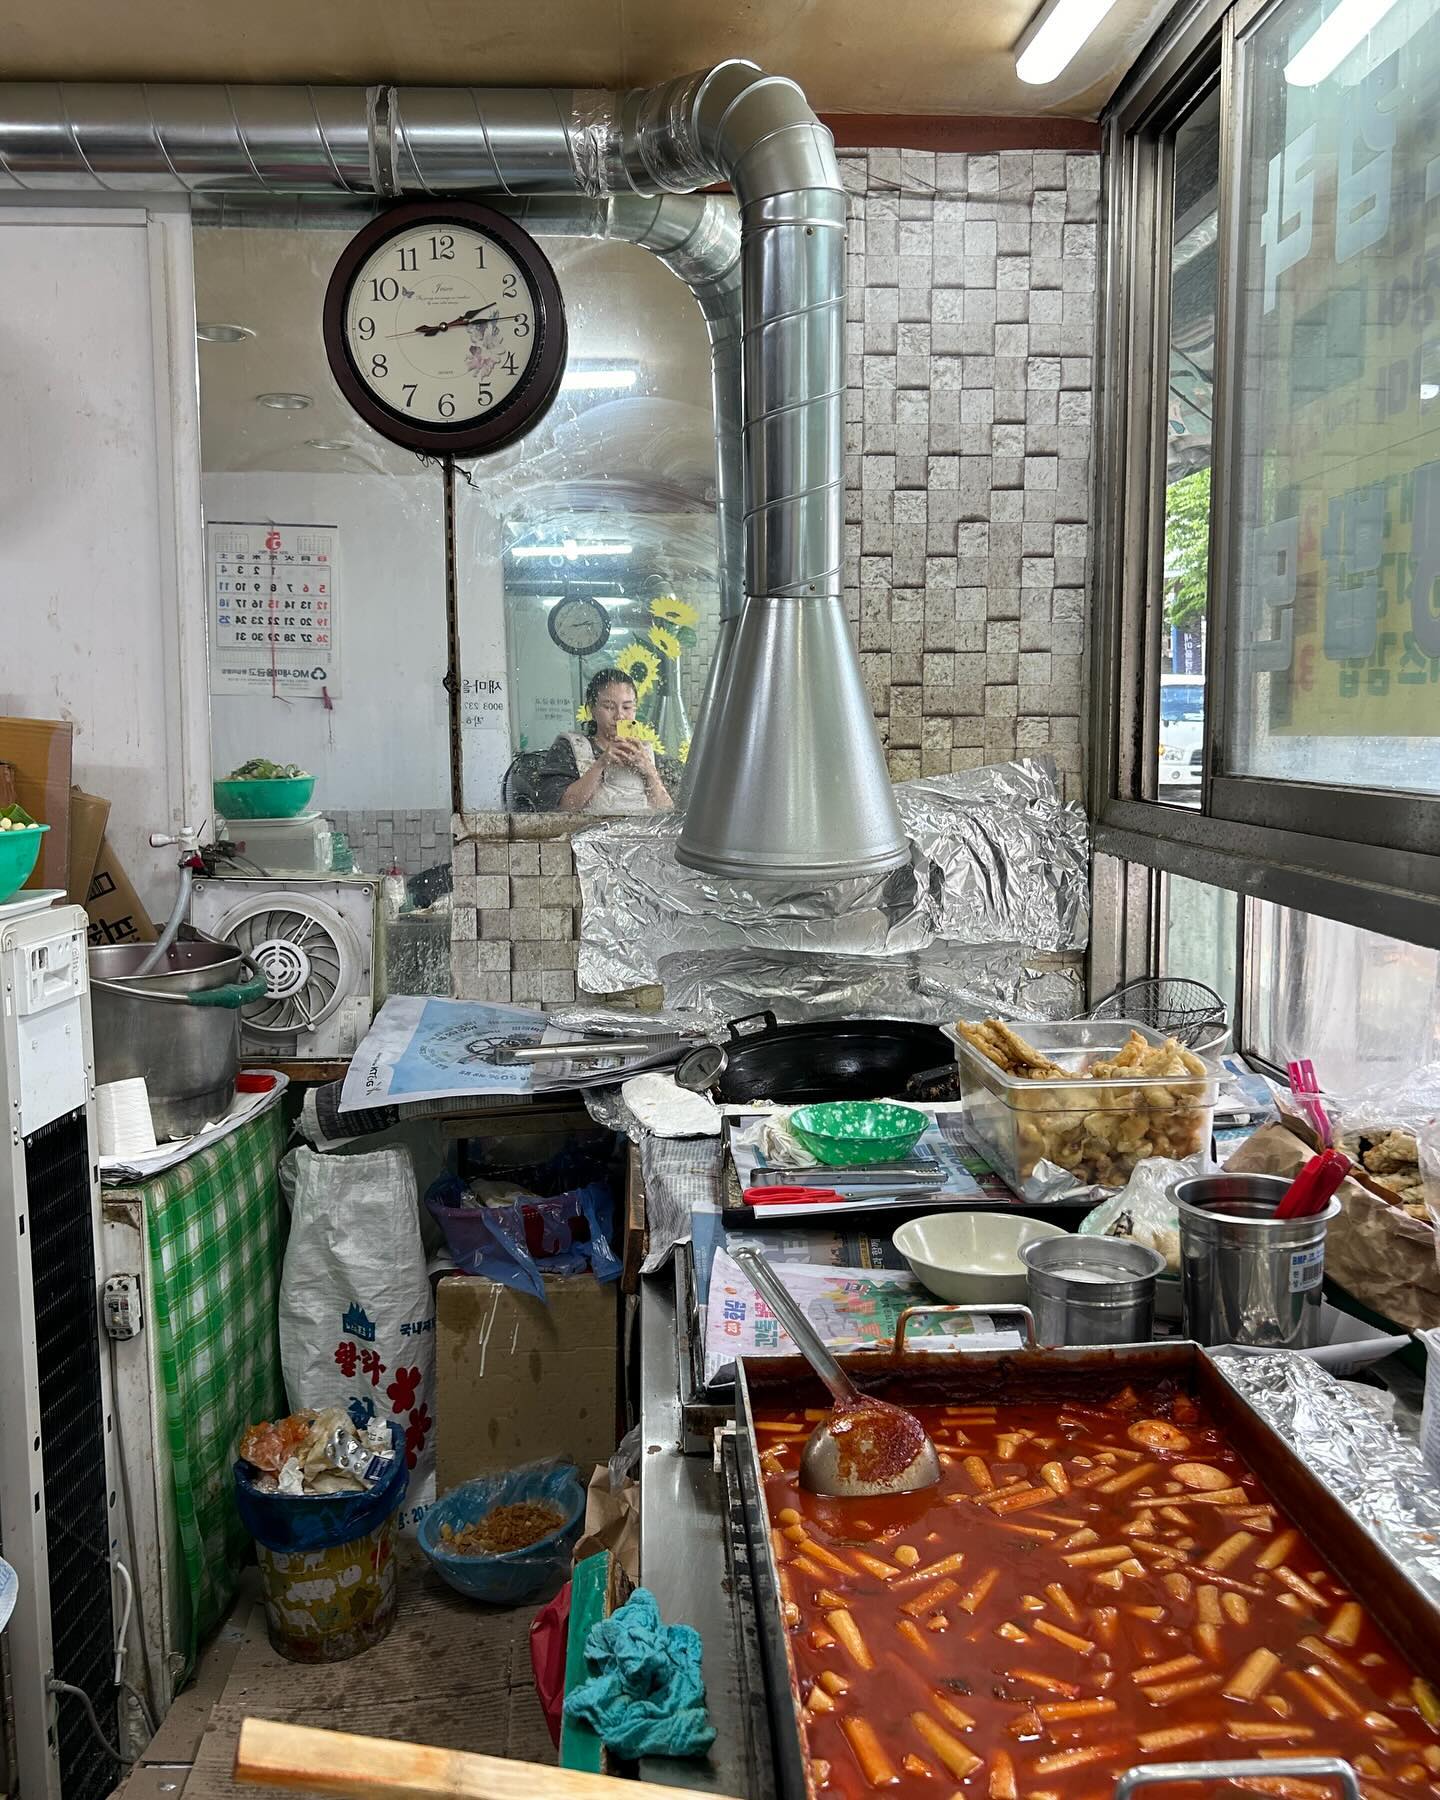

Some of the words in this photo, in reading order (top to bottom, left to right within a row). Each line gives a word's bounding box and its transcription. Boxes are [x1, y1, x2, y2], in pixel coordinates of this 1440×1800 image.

[397, 247, 420, 272] 11
[428, 235, 455, 261] 12
[475, 245, 487, 270] 1
[370, 277, 399, 302] 10
[502, 273, 518, 299] 2
[358, 316, 376, 341] 9
[513, 313, 530, 338] 3
[371, 353, 389, 378] 8
[501, 351, 519, 376] 4
[402, 383, 418, 408] 7
[437, 393, 456, 418] 6
[477, 382, 494, 407] 5
